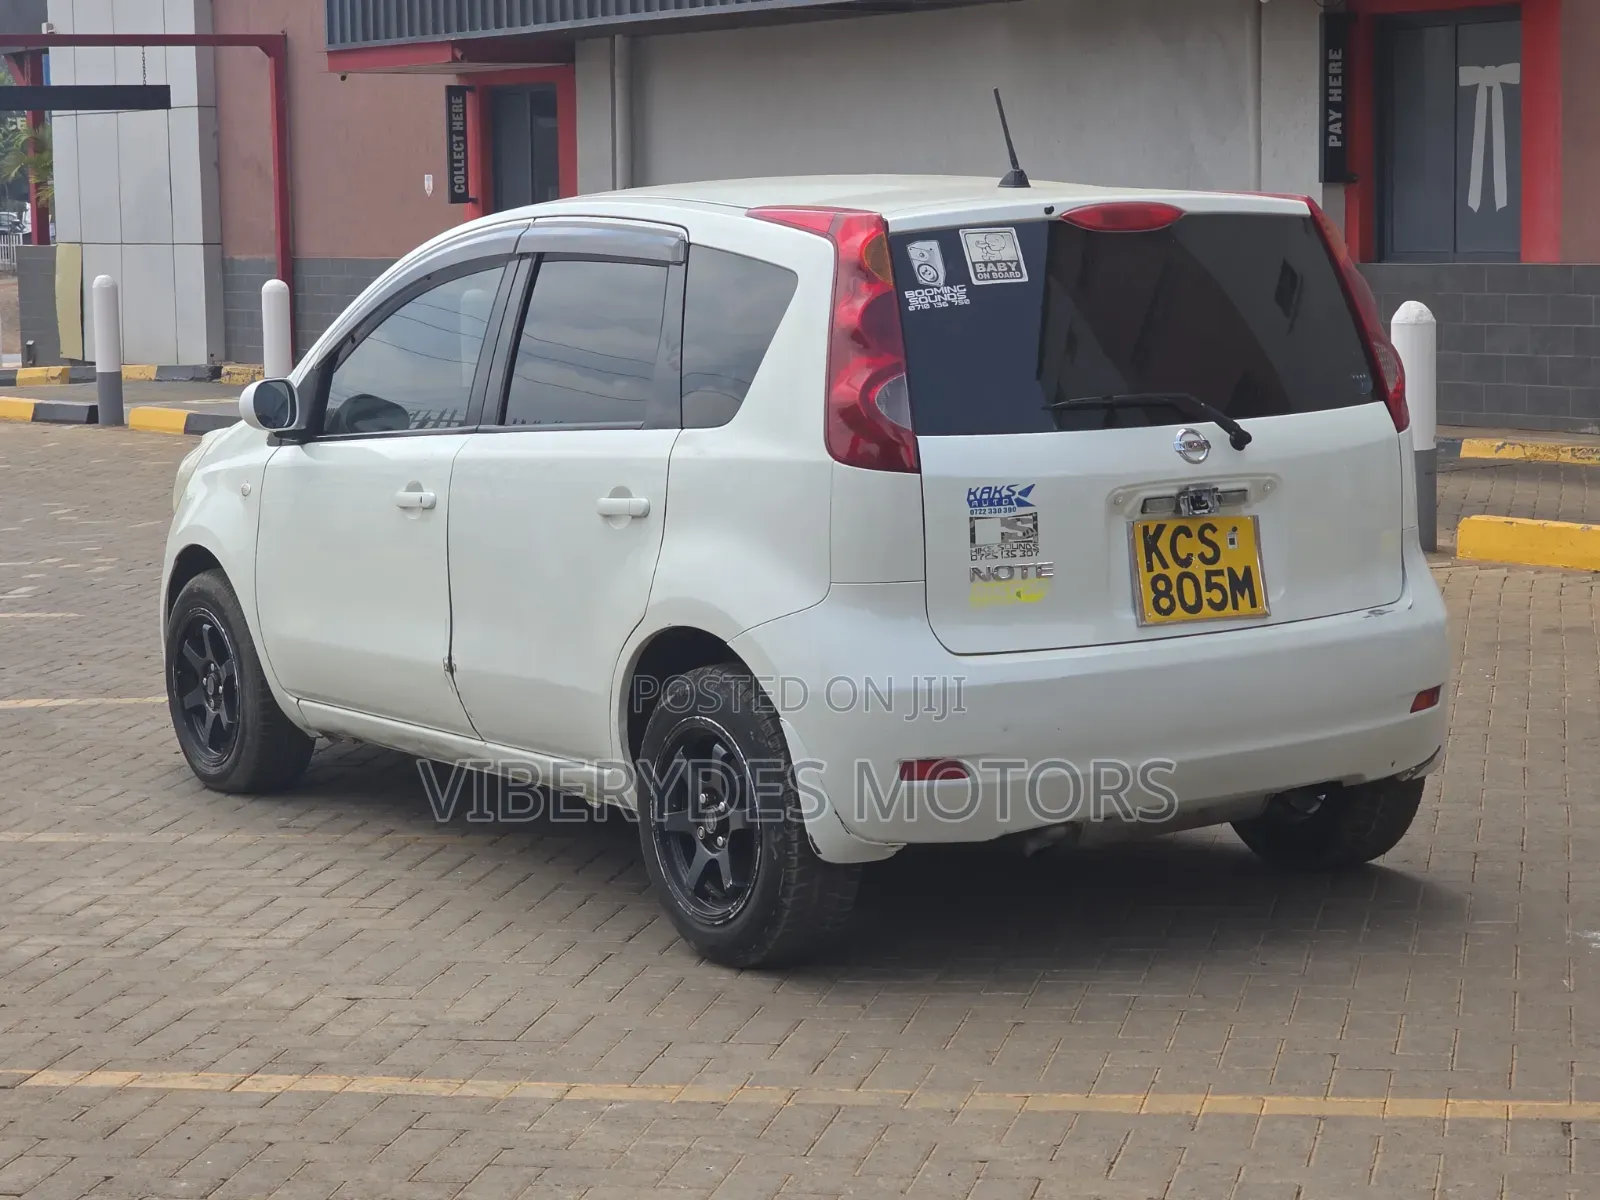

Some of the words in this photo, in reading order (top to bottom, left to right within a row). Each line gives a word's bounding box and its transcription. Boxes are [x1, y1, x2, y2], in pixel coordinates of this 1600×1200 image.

[1328, 48, 1342, 102] HERE
[451, 95, 464, 131] HERE
[1328, 109, 1342, 147] PAY
[452, 134, 465, 194] COLLECT
[974, 261, 1018, 273] BABY
[977, 272, 991, 280] ON
[992, 270, 1022, 280] BOARD
[904, 284, 967, 299] BOOMING
[908, 292, 967, 306] SOUNDS
[966, 484, 1020, 501] KAKS
[971, 499, 1010, 507] AUTO
[969, 508, 987, 516] 0722
[988, 507, 1002, 515] 330
[998, 542, 1040, 552] SOUNDS
[1019, 549, 1040, 558] 307
[1142, 522, 1221, 573] KCS
[969, 561, 1054, 582] NOTE
[1150, 565, 1258, 617] 805M
